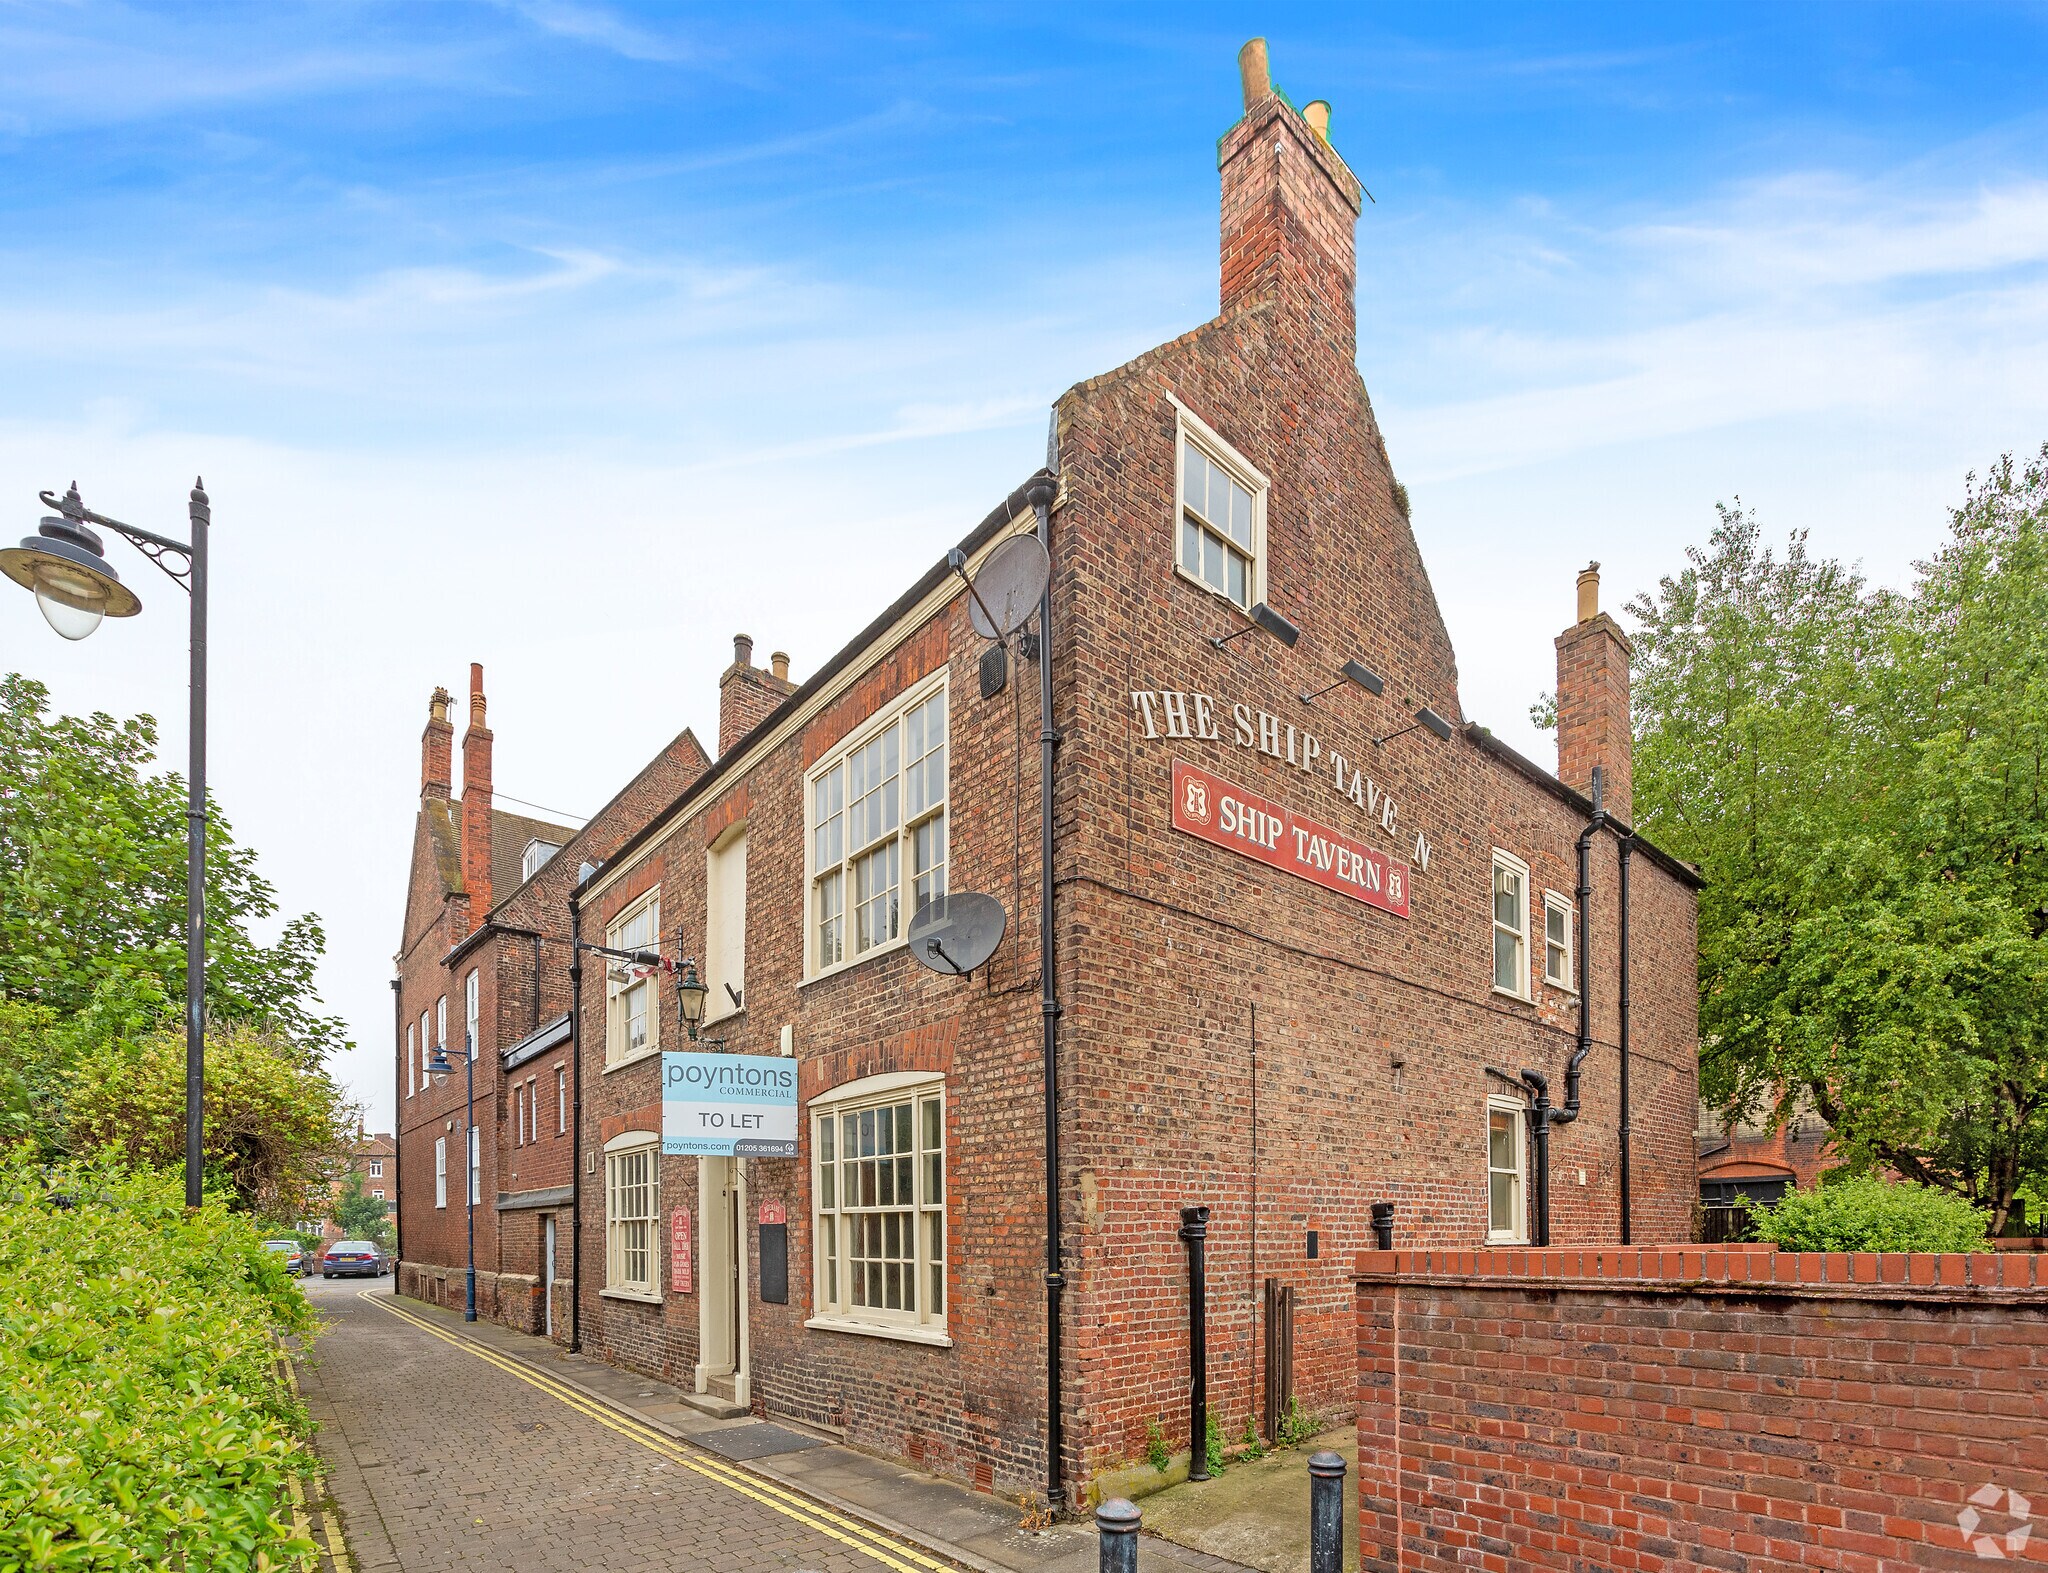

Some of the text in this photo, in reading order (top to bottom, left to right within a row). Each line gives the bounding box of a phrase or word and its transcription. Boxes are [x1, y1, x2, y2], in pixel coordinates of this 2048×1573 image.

[1131, 690, 1219, 740] THE
[1232, 702, 1321, 774] SHIP
[1219, 795, 1382, 894] SHIP TAVERN
[668, 1063, 792, 1089] poyntons
[719, 1086, 792, 1099] COMMERCIAL
[698, 1112, 764, 1129] TO LET
[666, 1141, 731, 1151] poyntons.com
[736, 1144, 758, 1152] 01205
[674, 1231, 688, 1241] OPEN
